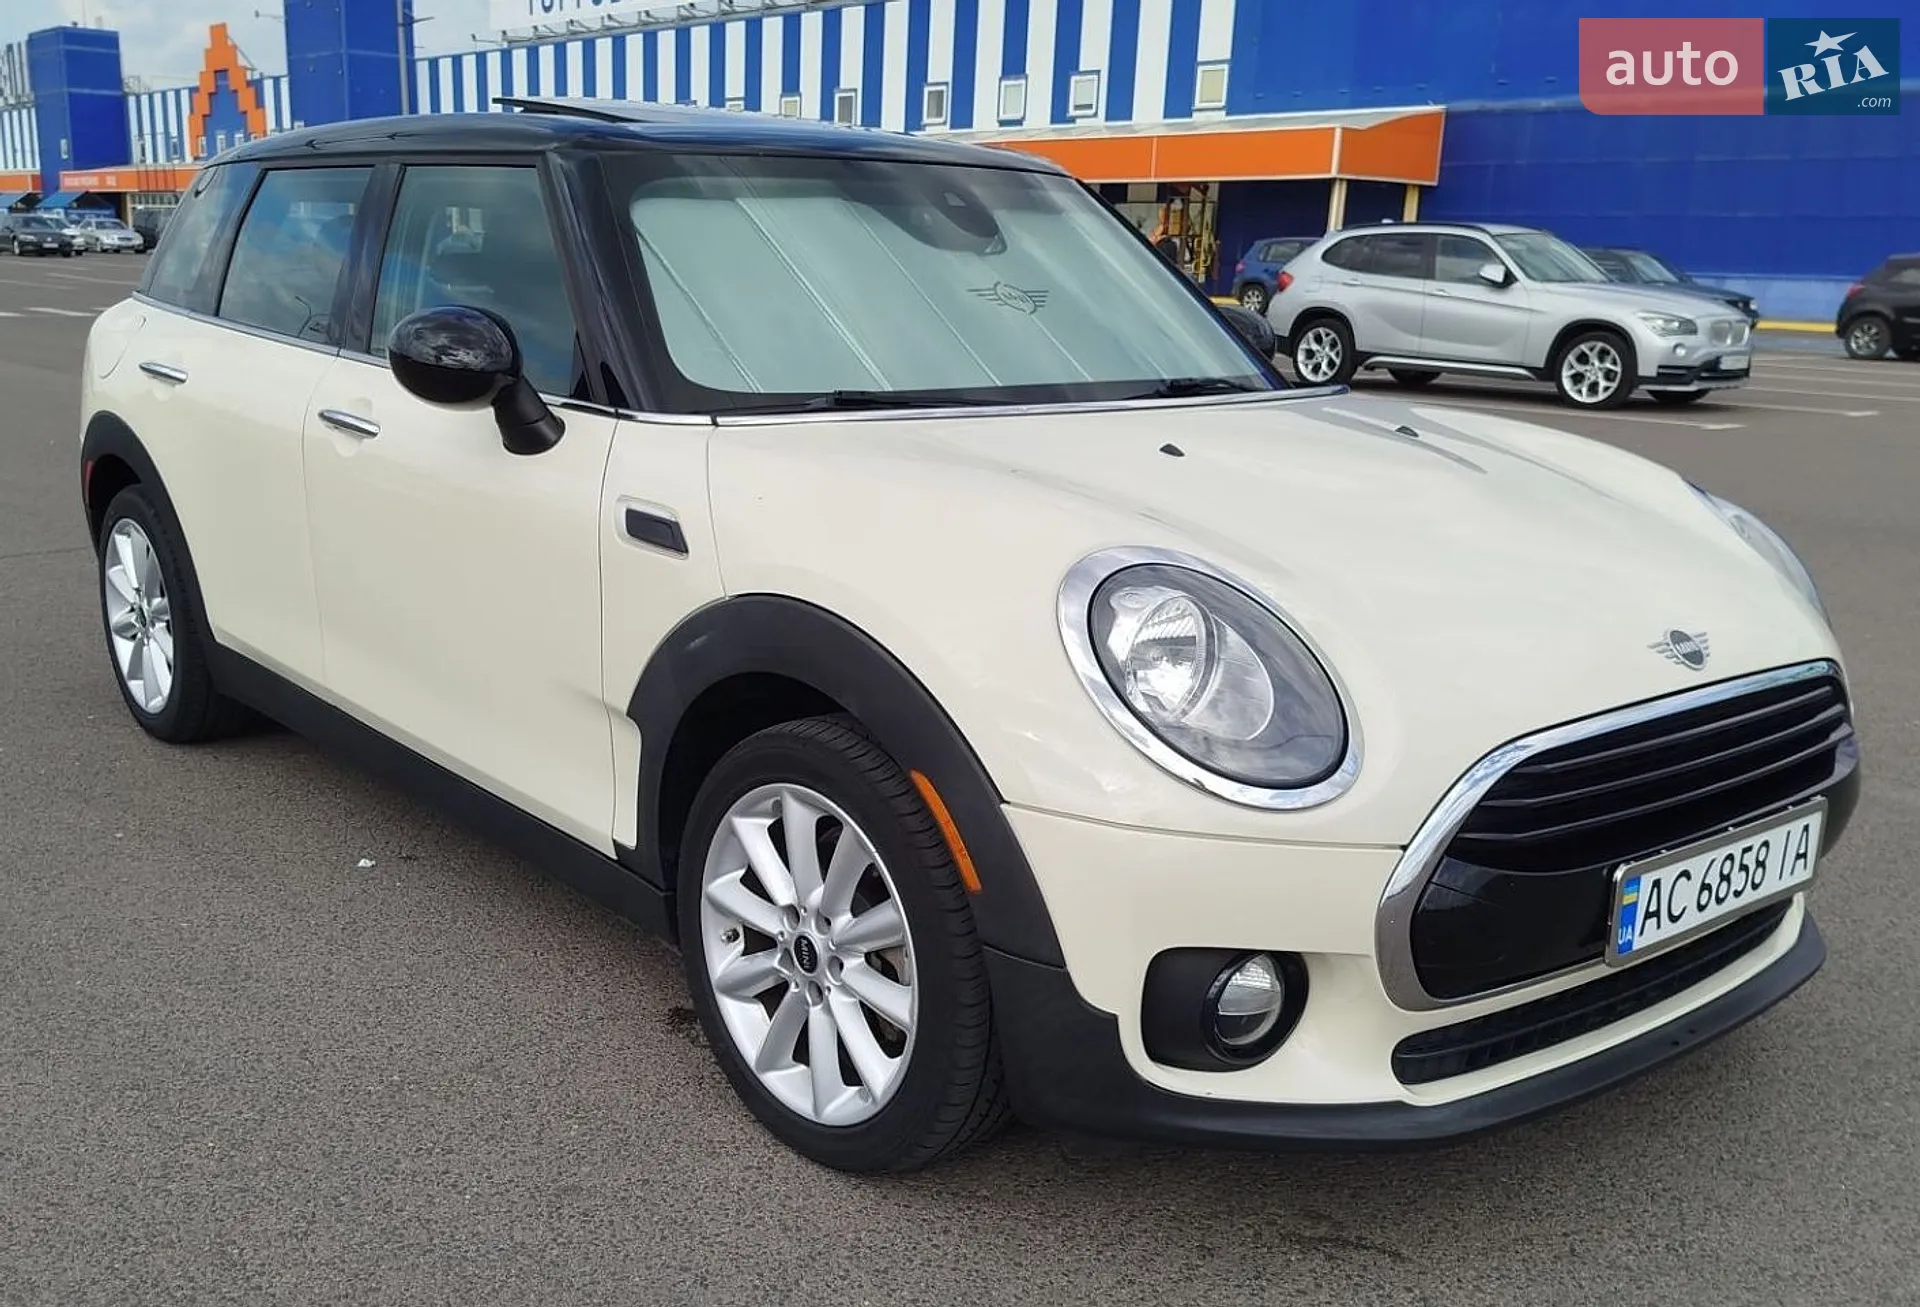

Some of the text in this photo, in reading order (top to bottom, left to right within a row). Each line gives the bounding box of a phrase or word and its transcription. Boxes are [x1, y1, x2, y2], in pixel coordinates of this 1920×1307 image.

[1639, 823, 1810, 937] AC 6858 IA
[1618, 925, 1633, 945] UA
